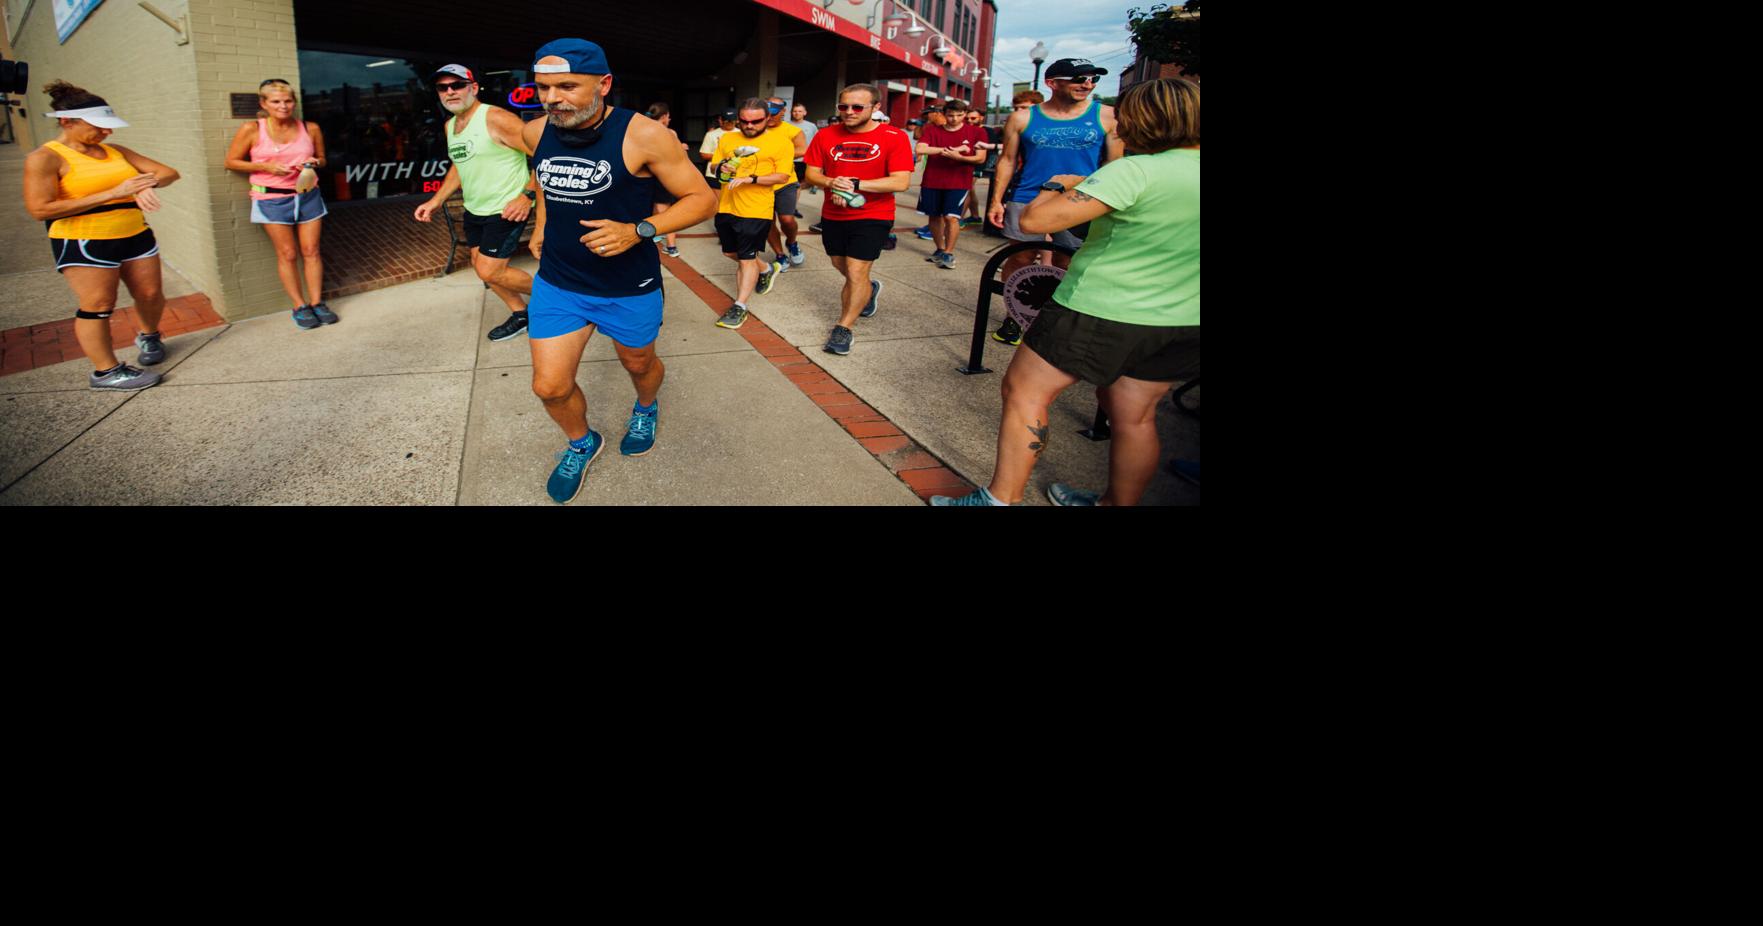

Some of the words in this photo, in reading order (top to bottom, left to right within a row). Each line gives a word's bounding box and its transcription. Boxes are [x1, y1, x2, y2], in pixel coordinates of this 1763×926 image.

[811, 7, 836, 32] SWIM
[345, 161, 415, 184] WITH
[420, 160, 449, 178] US
[539, 159, 595, 178] Running
[549, 175, 590, 190] soles
